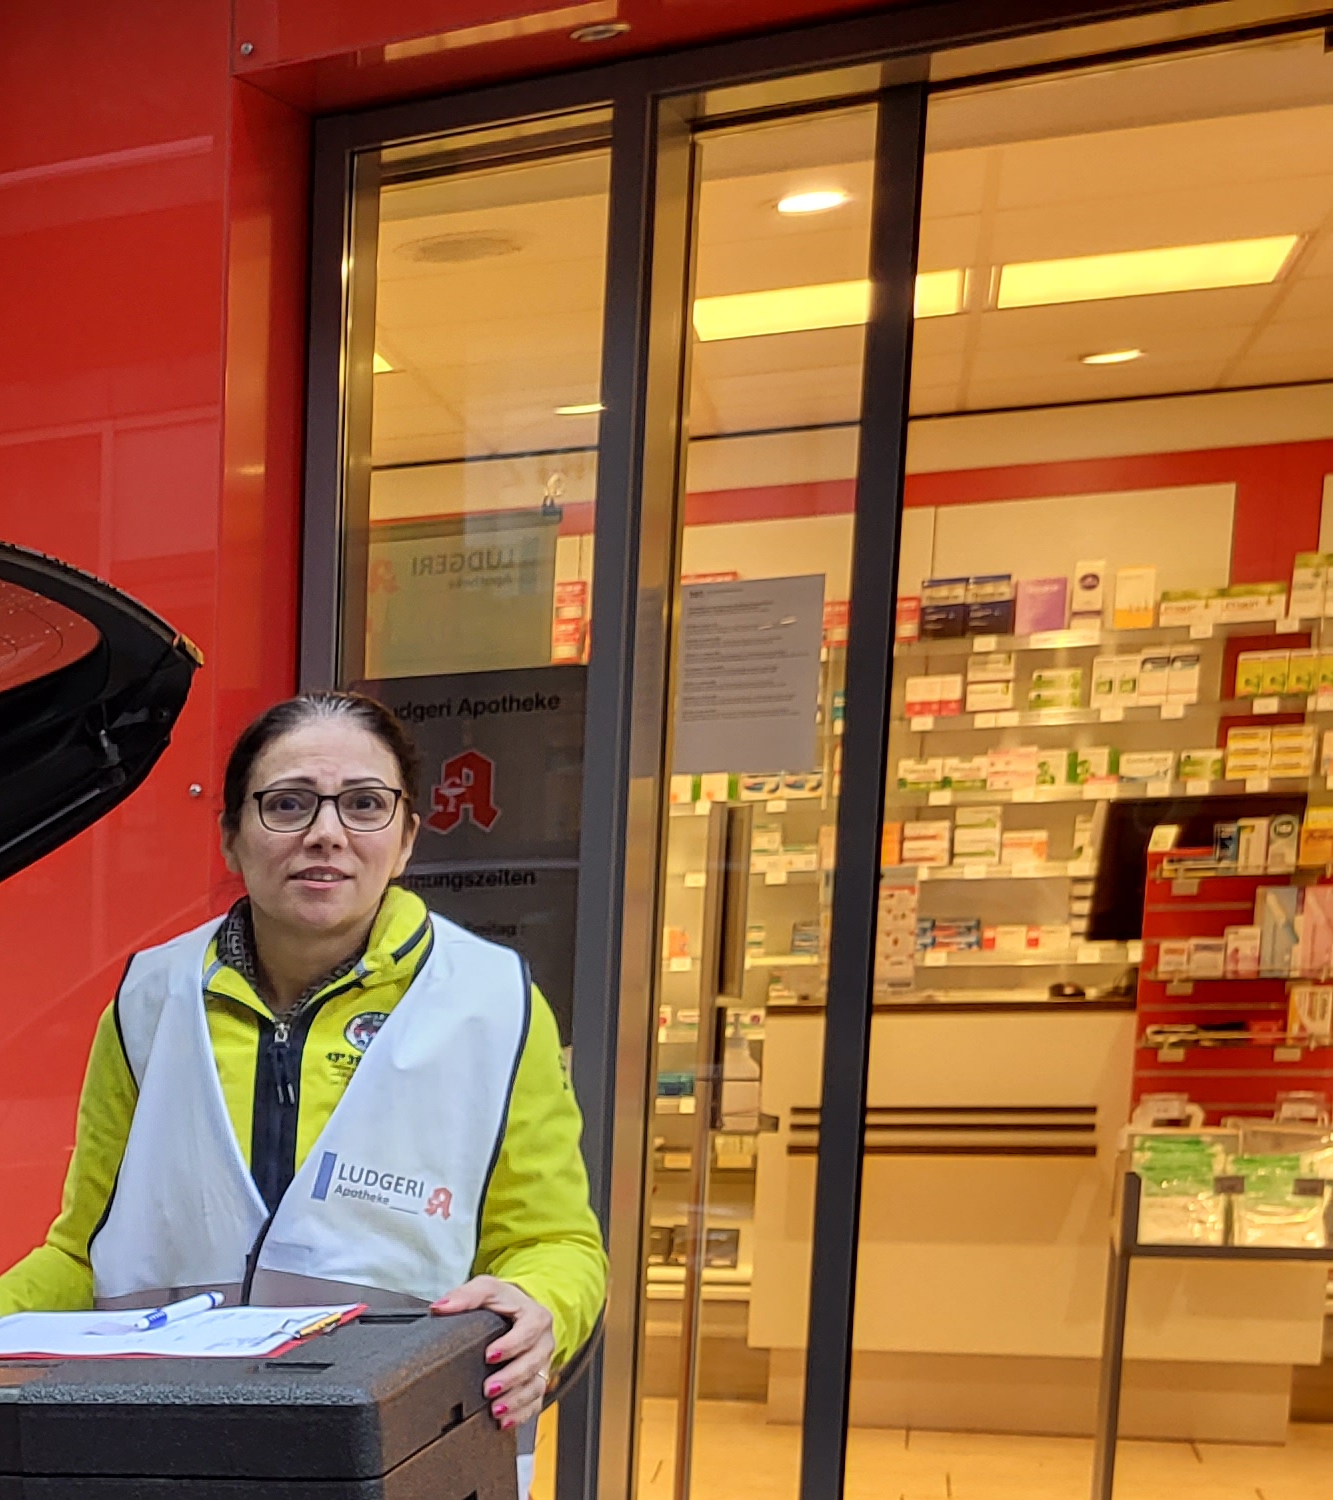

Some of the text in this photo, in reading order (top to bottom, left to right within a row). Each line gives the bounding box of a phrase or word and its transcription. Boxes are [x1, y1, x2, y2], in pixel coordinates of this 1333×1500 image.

[457, 692, 561, 720] Apotheke
[334, 1184, 390, 1206] Apotheke
[337, 1163, 425, 1199] LUDGERI
